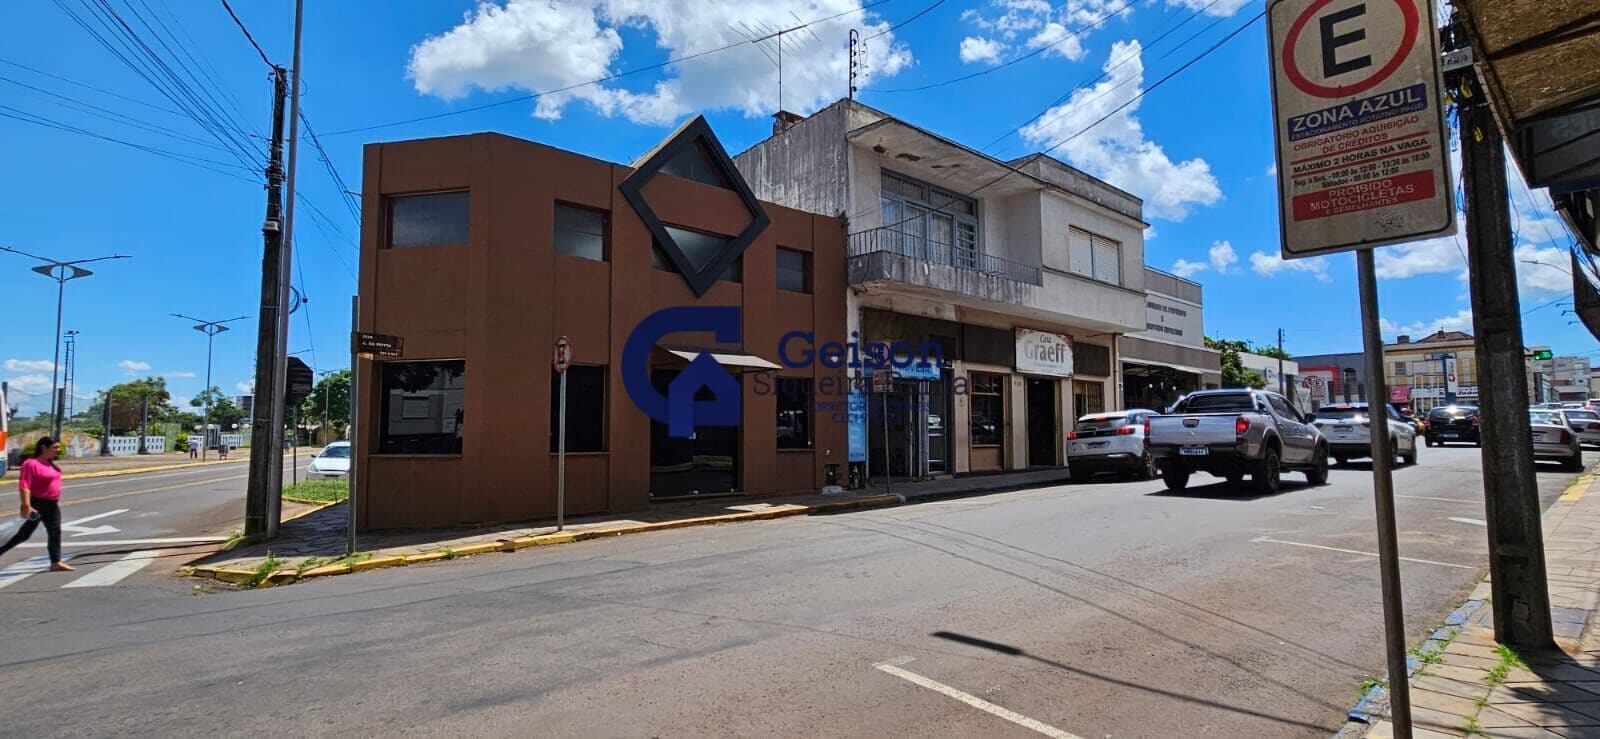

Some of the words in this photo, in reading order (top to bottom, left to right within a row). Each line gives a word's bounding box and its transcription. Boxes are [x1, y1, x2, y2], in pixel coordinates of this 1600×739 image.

[1319, 3, 1372, 79] E
[1291, 119, 1359, 141] ESTACIONAMENTO
[1360, 108, 1399, 125] ROTATIVO
[1293, 107, 1357, 132] ZONA
[1359, 88, 1421, 116] AZUL
[1294, 129, 1360, 151] OBRIGATÓRIO
[1362, 115, 1419, 137] AQUISIÇÃO
[1293, 160, 1331, 174] MÁXIMO
[1333, 158, 1340, 166] 2
[1342, 151, 1378, 164] HORAS
[1380, 146, 1395, 154] NA
[1397, 138, 1428, 151] VAGA
[1322, 145, 1336, 154] DE
[1310, 184, 1415, 212] MOTOCICLETAS
[1328, 179, 1392, 198] PROIBIDO
[1332, 197, 1399, 214] SEMELHANTES
[1024, 339, 1067, 364] Graeff
